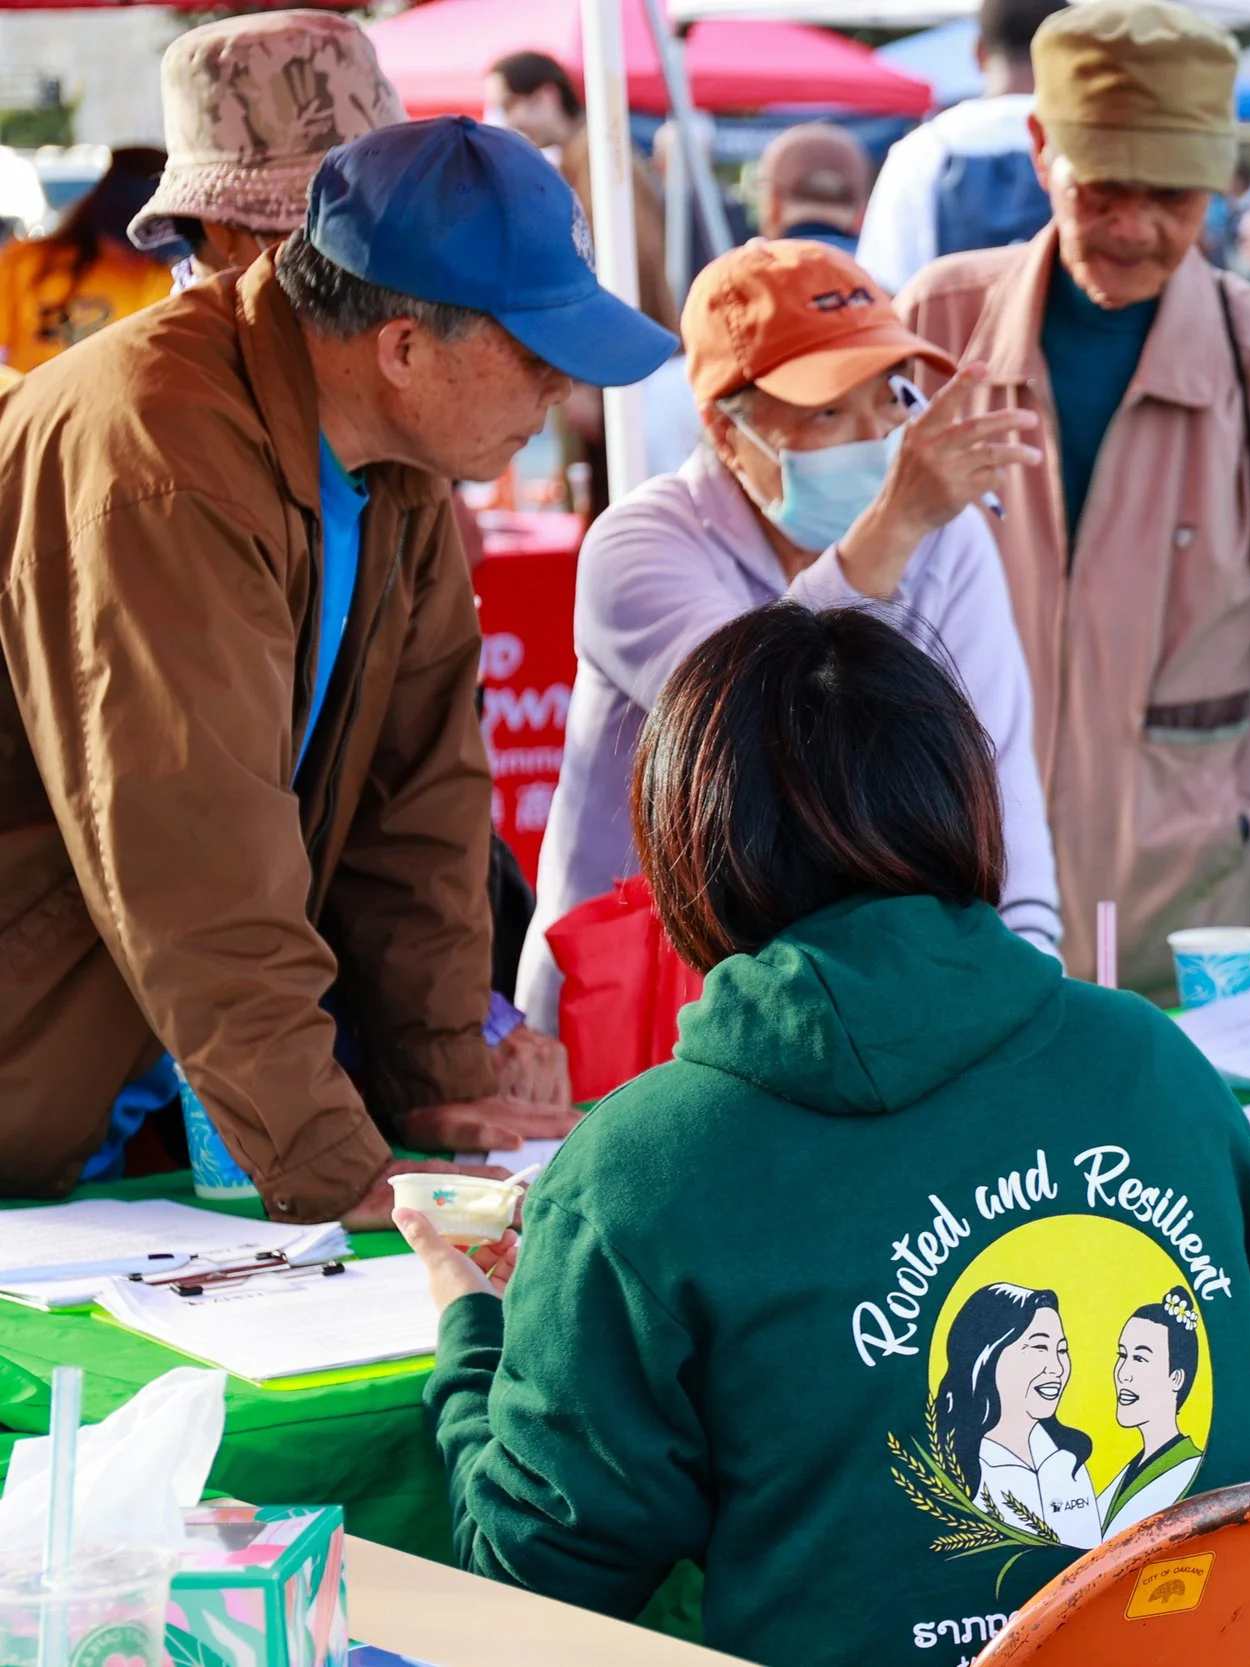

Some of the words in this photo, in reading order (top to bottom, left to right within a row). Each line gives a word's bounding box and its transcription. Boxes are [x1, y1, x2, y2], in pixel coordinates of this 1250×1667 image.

[852, 1195, 970, 1367] Rooted
[975, 1149, 1057, 1220] and
[1074, 1145, 1232, 1301] Resilient
[1064, 1497, 1089, 1511] APEN
[1142, 1573, 1158, 1586] CITY
[1160, 1569, 1170, 1577] OF
[1173, 1566, 1205, 1576] OAKLAND
